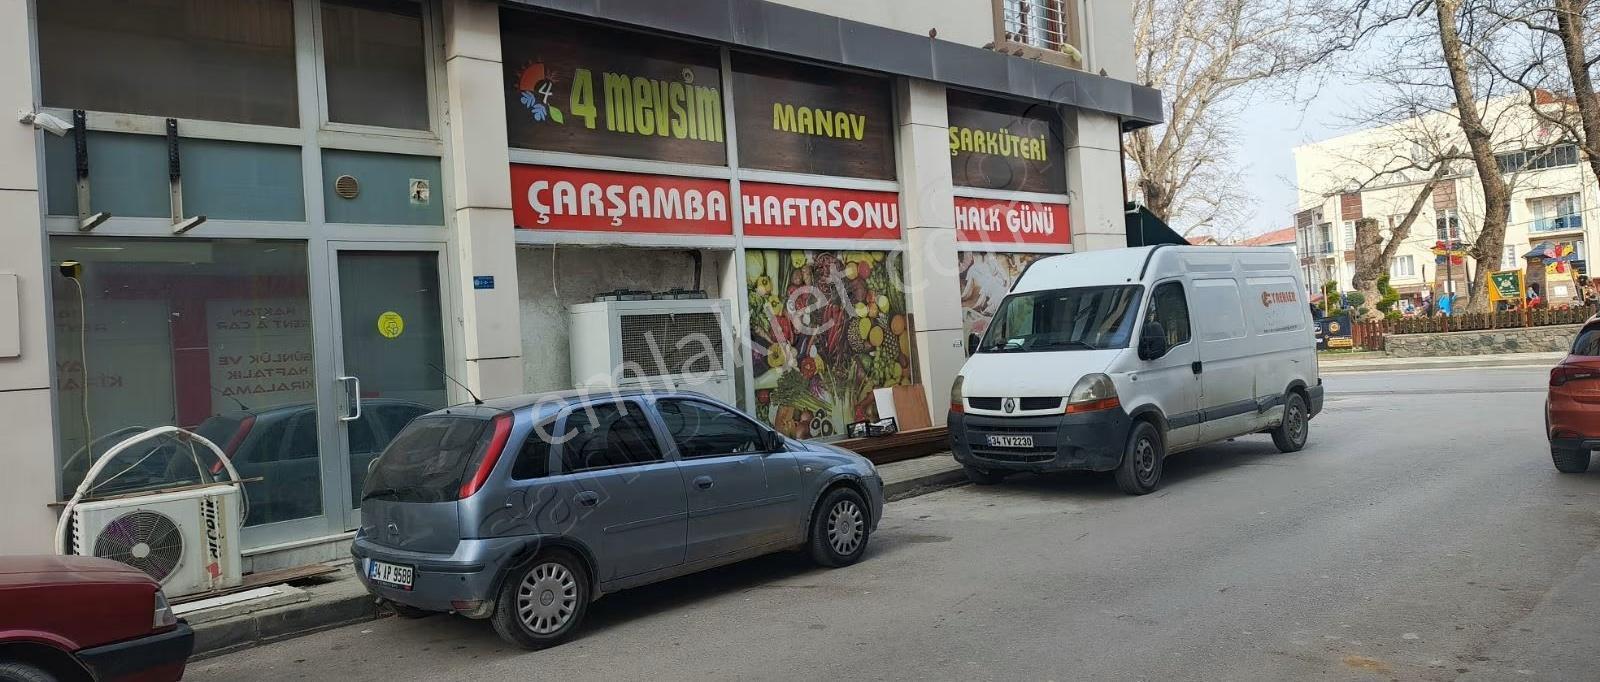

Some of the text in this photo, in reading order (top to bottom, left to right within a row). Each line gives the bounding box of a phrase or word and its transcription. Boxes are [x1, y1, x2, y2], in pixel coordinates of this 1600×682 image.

[538, 82, 552, 103] 4
[570, 68, 597, 129] 4
[773, 102, 866, 141] MANAV
[949, 126, 1047, 161] ŞARKÜTERİ
[527, 180, 727, 226] ÇARŞAMBA
[742, 194, 898, 229] HAFTASONU
[955, 203, 1055, 234] HALK GÜNÜ
[992, 436, 1032, 446] 34 TV 2230
[383, 565, 391, 581] AP
